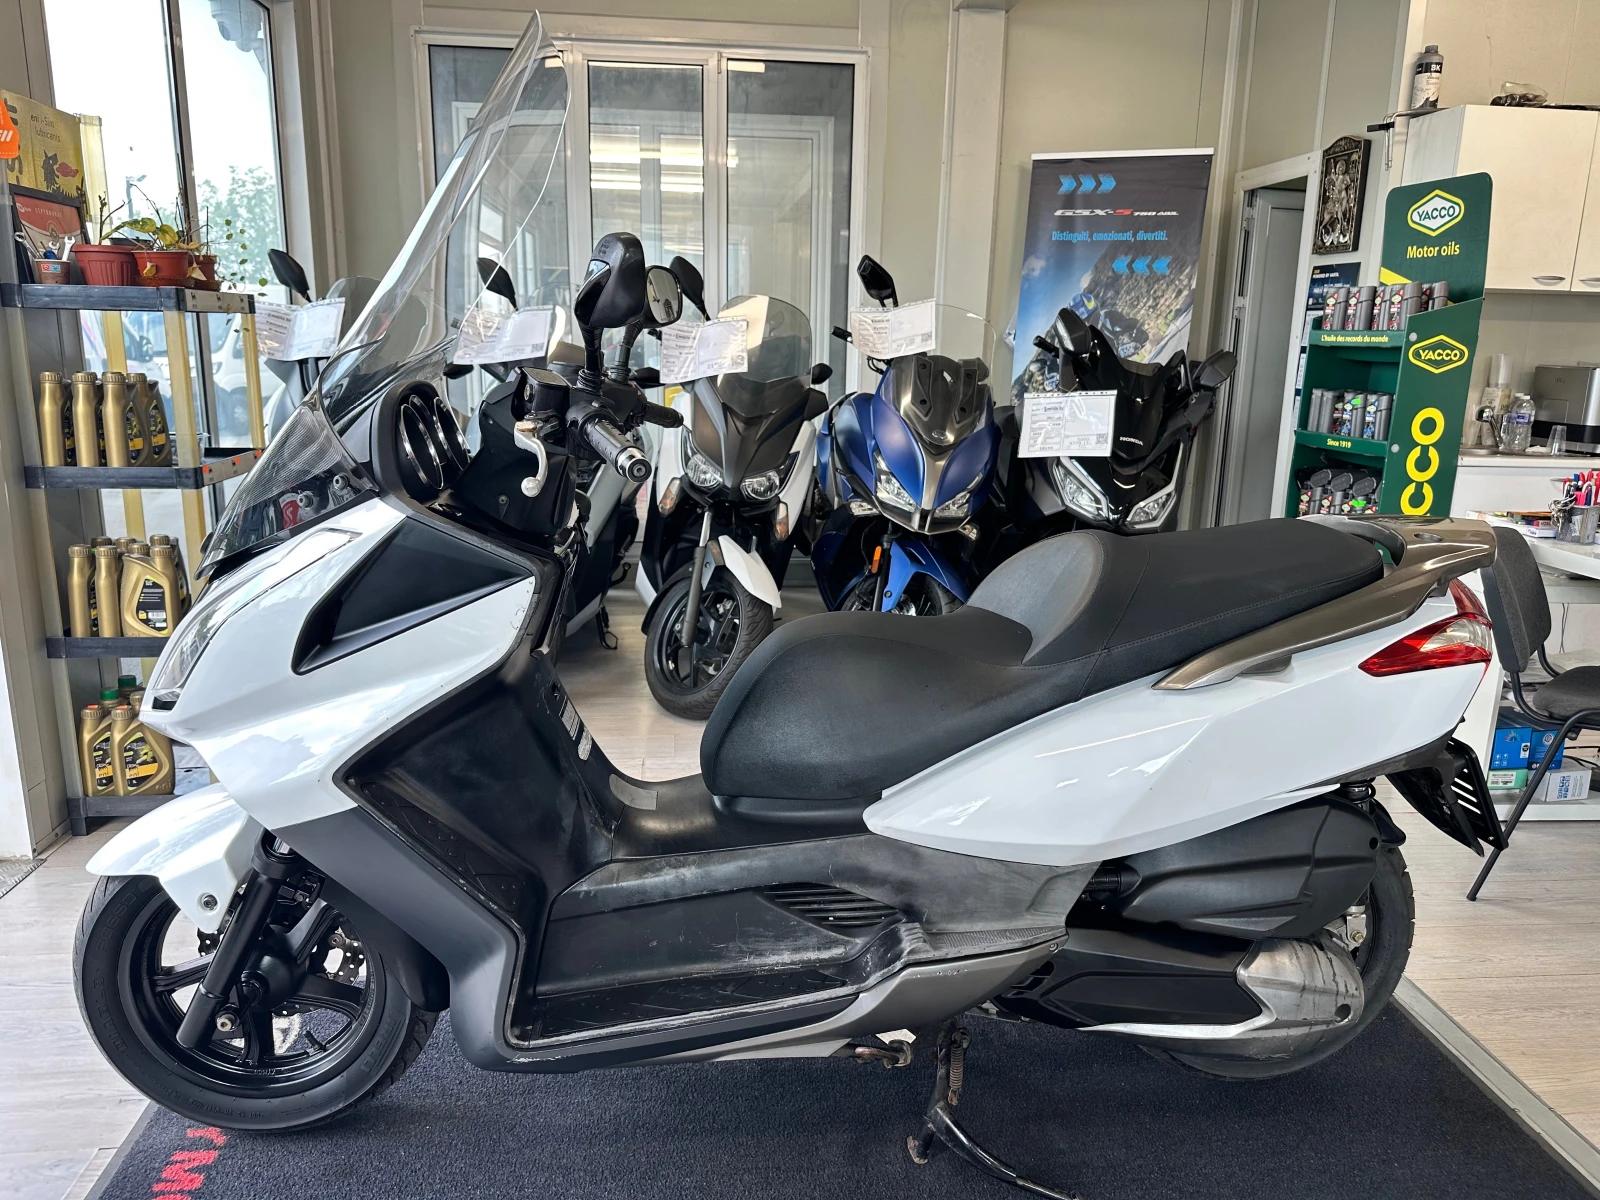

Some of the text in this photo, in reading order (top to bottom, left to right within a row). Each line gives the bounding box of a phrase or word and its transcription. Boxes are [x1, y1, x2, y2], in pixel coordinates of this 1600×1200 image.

[34, 125, 61, 143] lubricants
[1053, 208, 1133, 216] GSX-S
[1416, 204, 1456, 222] YACCO
[1051, 230, 1168, 243] Distinguiti, emozionati, divertiti.
[1406, 241, 1460, 259] Motor oils
[1321, 334, 1336, 342] L'huile
[1370, 335, 1389, 343] monde
[1418, 349, 1460, 361] YACCO
[1119, 436, 1144, 446] HONDA
[1326, 438, 1352, 448] Since 1919
[1400, 407, 1445, 516] CCO
[96, 892, 137, 953] ROSSO
